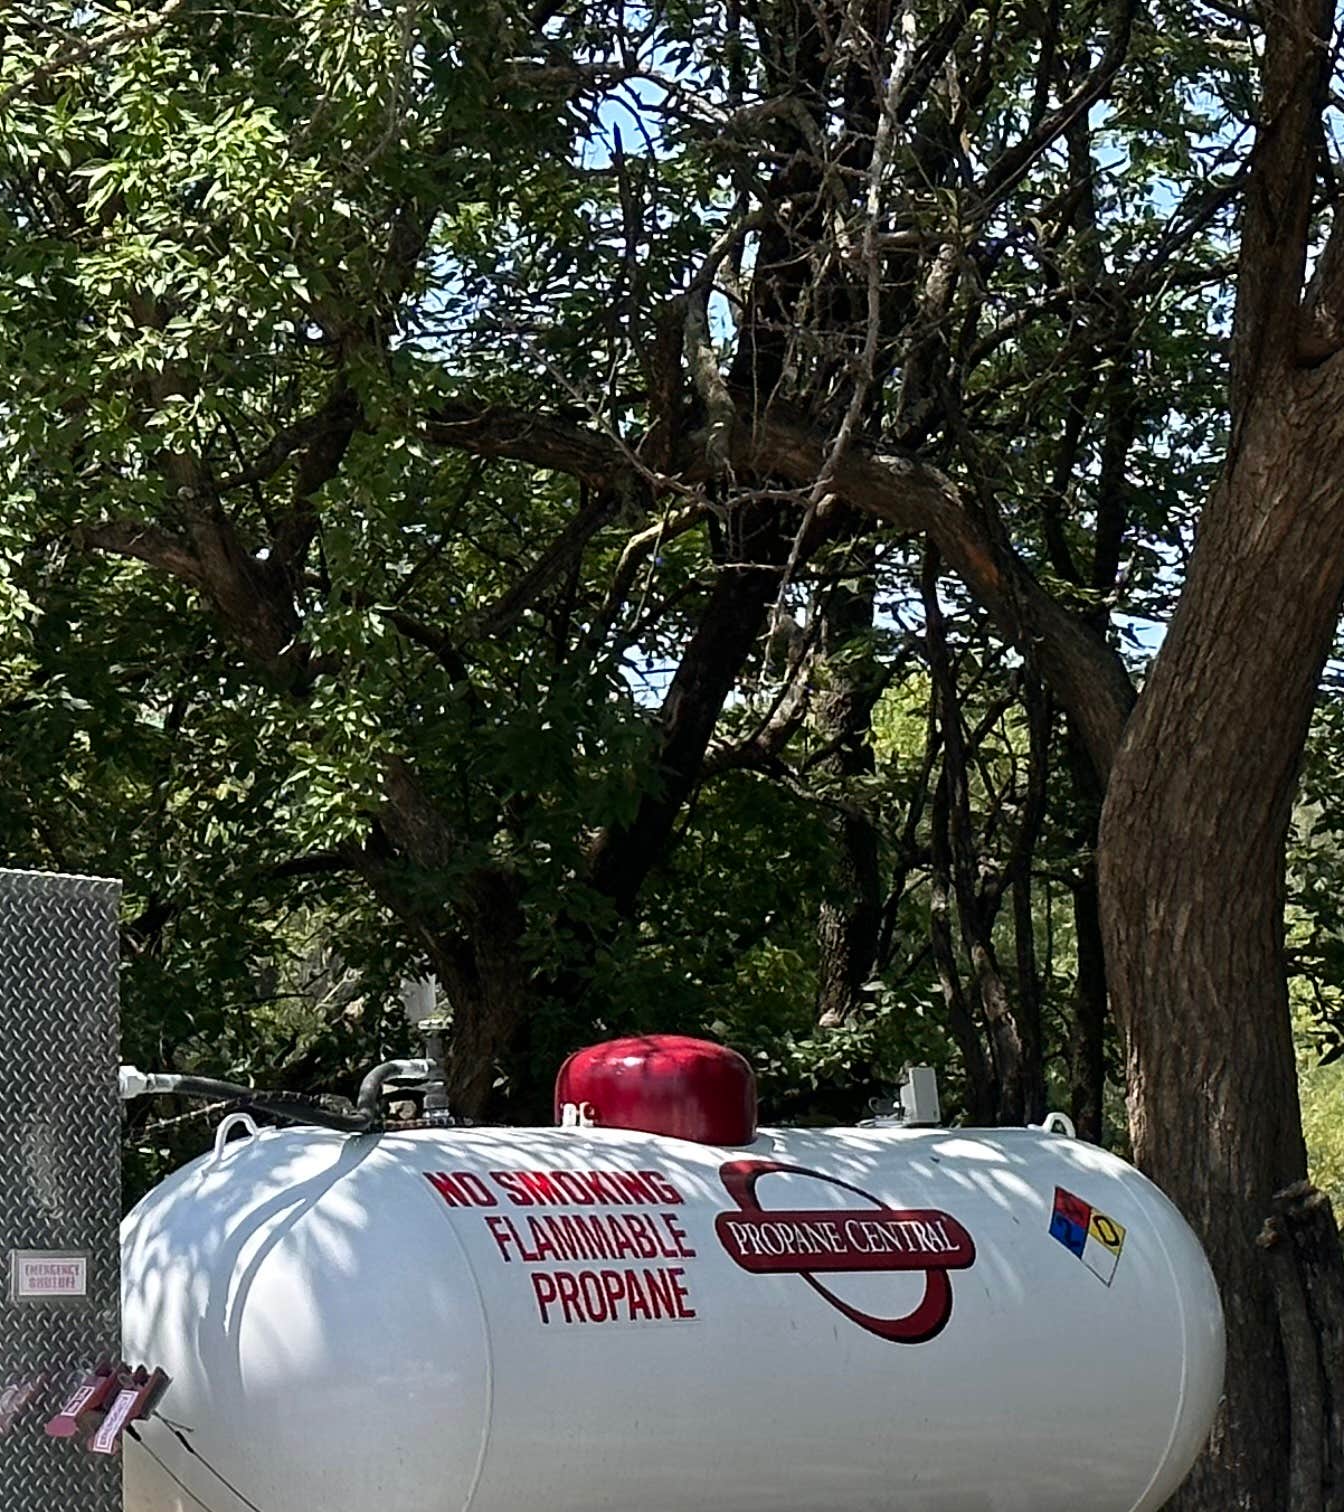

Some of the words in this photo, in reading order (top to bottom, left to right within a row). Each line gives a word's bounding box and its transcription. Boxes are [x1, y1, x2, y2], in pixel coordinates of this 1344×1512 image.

[423, 1172, 498, 1207] NO
[489, 1171, 685, 1206] SMOKING
[484, 1213, 696, 1261] FLAMMABLE
[726, 1221, 847, 1256] PROPANE
[845, 1219, 960, 1254] CENTRAL
[1092, 1215, 1120, 1246] 0
[531, 1268, 696, 1324] PROPANE
